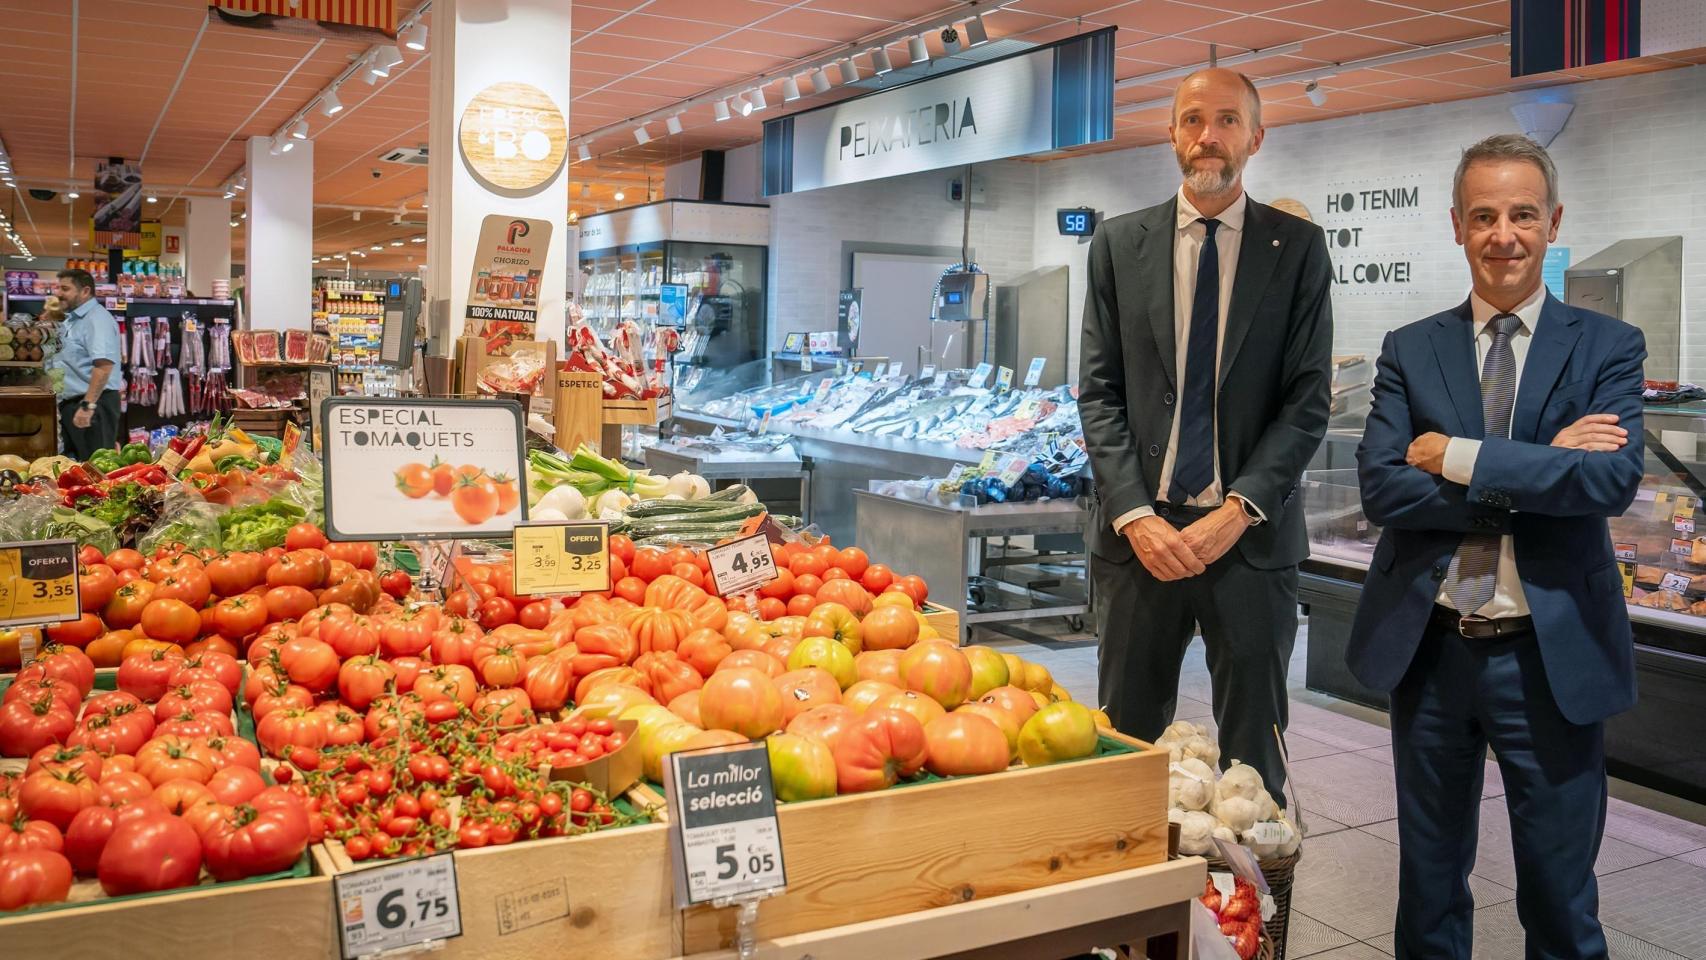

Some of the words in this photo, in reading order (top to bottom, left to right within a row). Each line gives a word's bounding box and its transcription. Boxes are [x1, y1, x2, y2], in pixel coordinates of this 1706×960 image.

[839, 96, 977, 161] PEIXATERIA
[1326, 192, 1355, 213] HO
[1359, 186, 1419, 211] TENIM
[1066, 215, 1085, 231] 58
[1326, 227, 1363, 248] TOT
[496, 245, 531, 253] PALACIOS
[493, 257, 530, 266] CHORIZO
[1353, 262, 1411, 284] COVE!
[471, 306, 493, 318] 100%
[493, 309, 535, 321] NATURAL
[559, 380, 599, 389] ESPETEC
[339, 408, 443, 426] ESPECIAL
[339, 427, 475, 450] TOMÀQUETS
[28, 557, 69, 566] OFERTA
[571, 556, 602, 572] 3,25
[731, 552, 770, 573] 4,95
[32, 581, 74, 600] 3,35
[687, 771, 709, 789] La
[713, 763, 762, 785] millor
[689, 785, 763, 812] selecció
[715, 844, 775, 881] 5,05
[376, 887, 449, 930] 6,75
